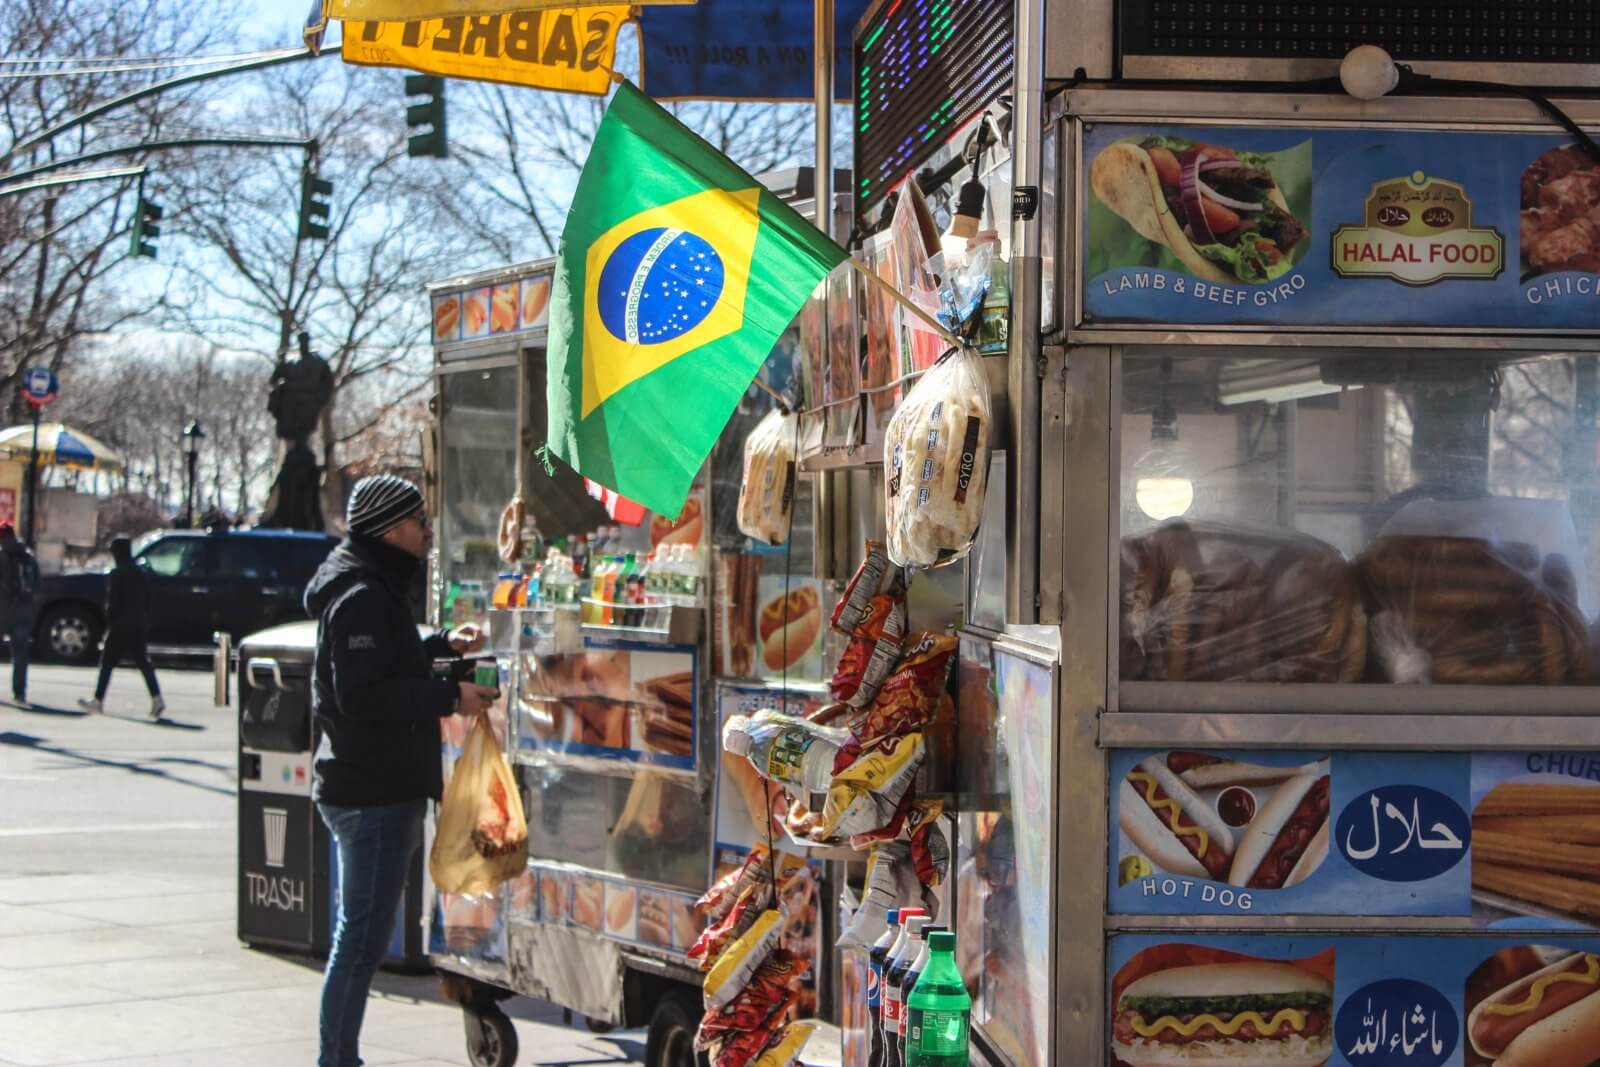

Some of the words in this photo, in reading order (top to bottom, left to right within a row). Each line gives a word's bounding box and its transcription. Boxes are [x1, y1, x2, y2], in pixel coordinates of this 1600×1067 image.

[1343, 242, 1422, 264] HALAL
[1429, 243, 1496, 264] FOOD
[1103, 272, 1166, 296] LAMB
[1174, 277, 1186, 293] &
[1194, 281, 1247, 305] BEEF
[1253, 273, 1306, 306] GYRO
[959, 452, 974, 489] GYRO
[1346, 793, 1463, 860] حلال
[245, 872, 305, 912] TRASH
[1142, 878, 1195, 899] HOT
[1201, 884, 1253, 910] DOG
